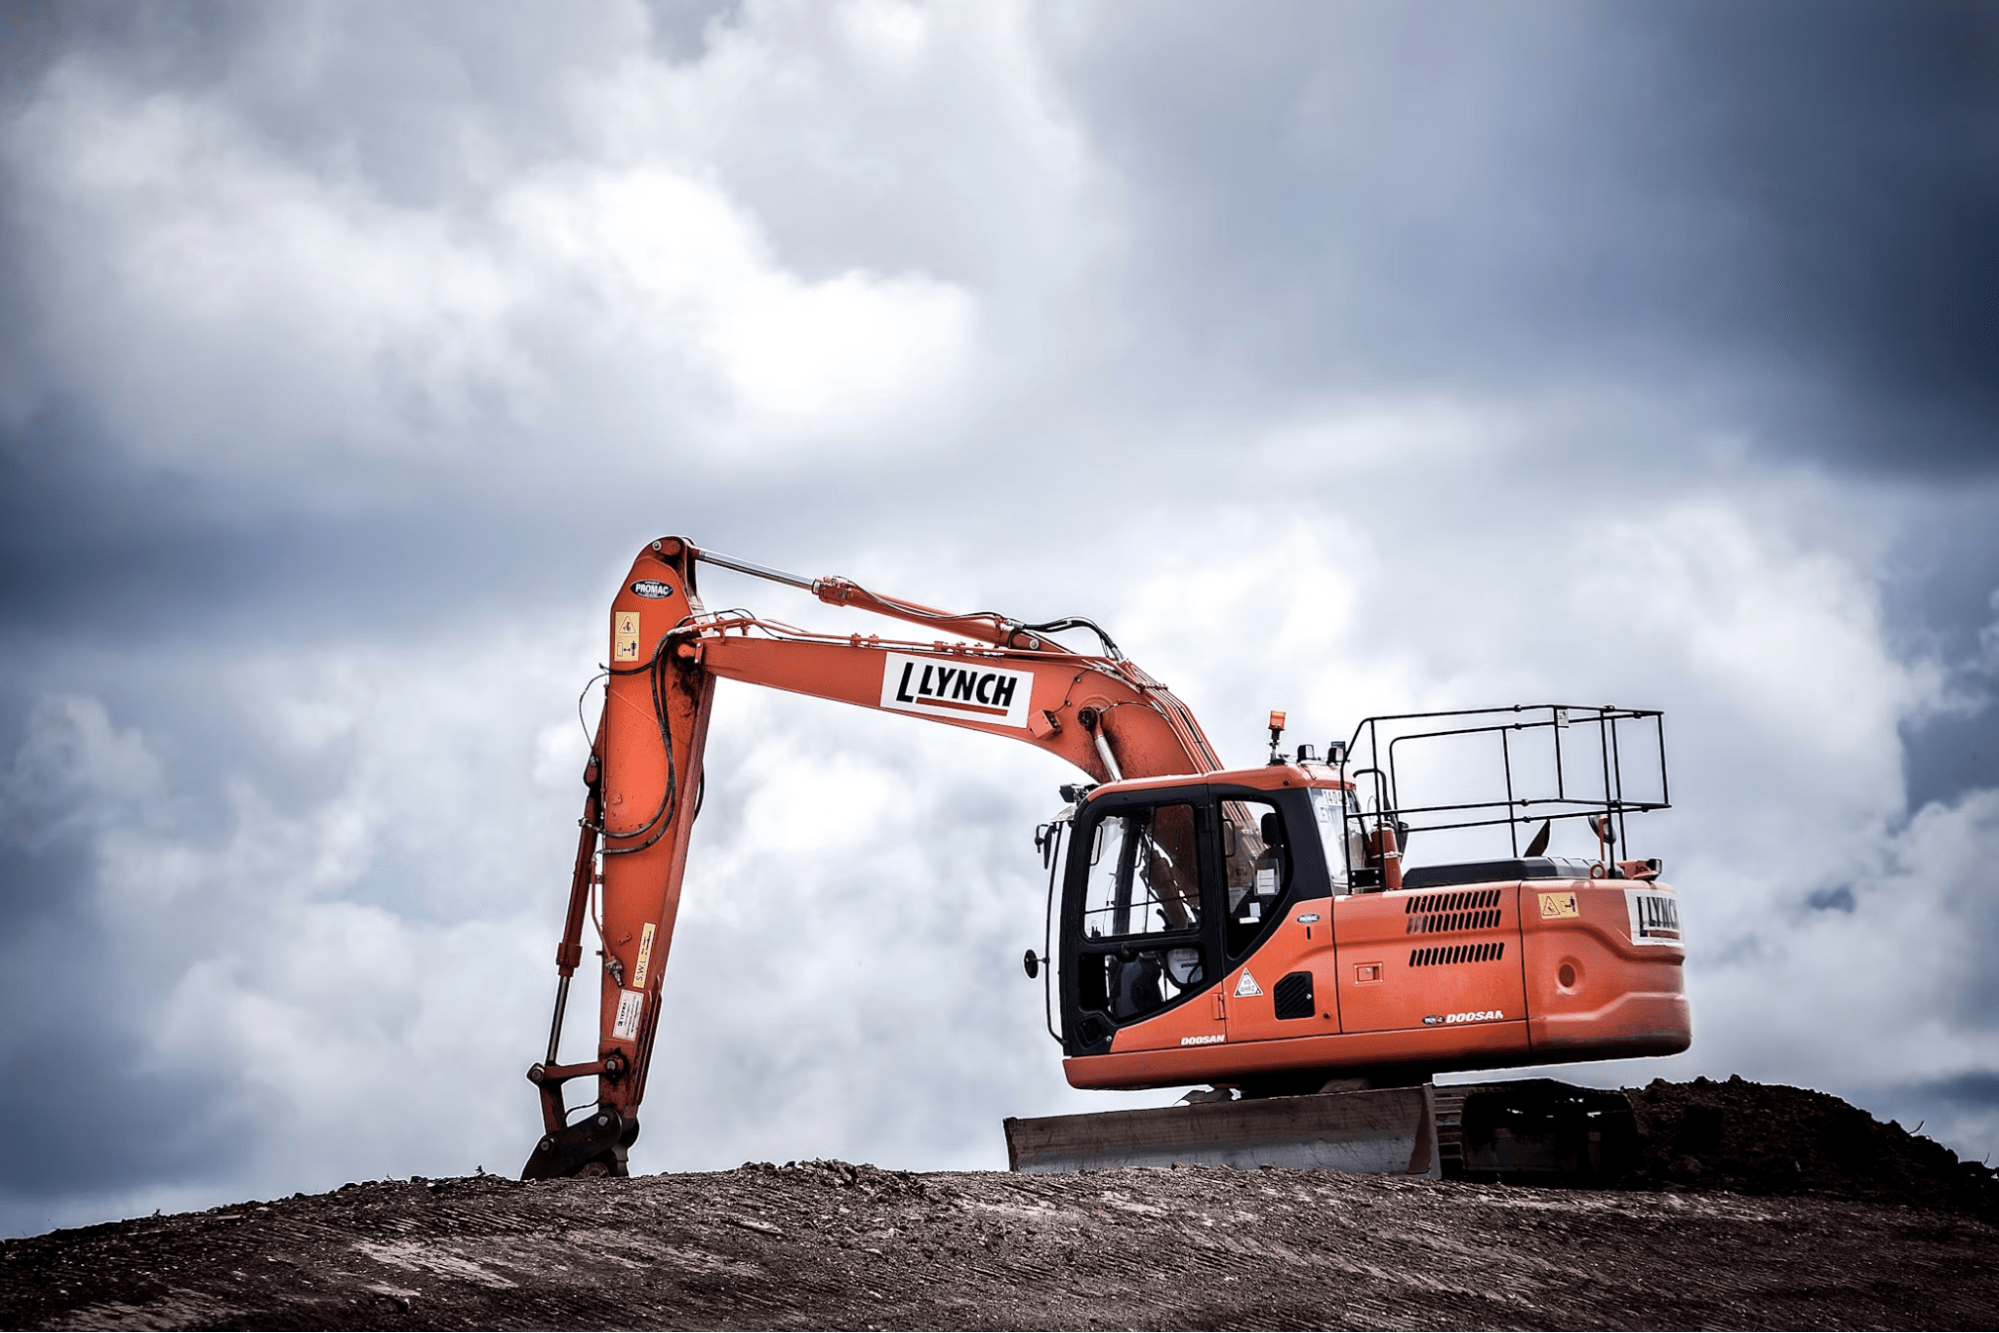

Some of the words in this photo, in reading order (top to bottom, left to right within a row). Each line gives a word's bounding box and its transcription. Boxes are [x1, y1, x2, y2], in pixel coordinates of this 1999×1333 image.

[635, 583, 669, 595] PROMAC
[1446, 1010, 1504, 1024] DOOSAN
[1180, 1034, 1225, 1046] DOOSAN
